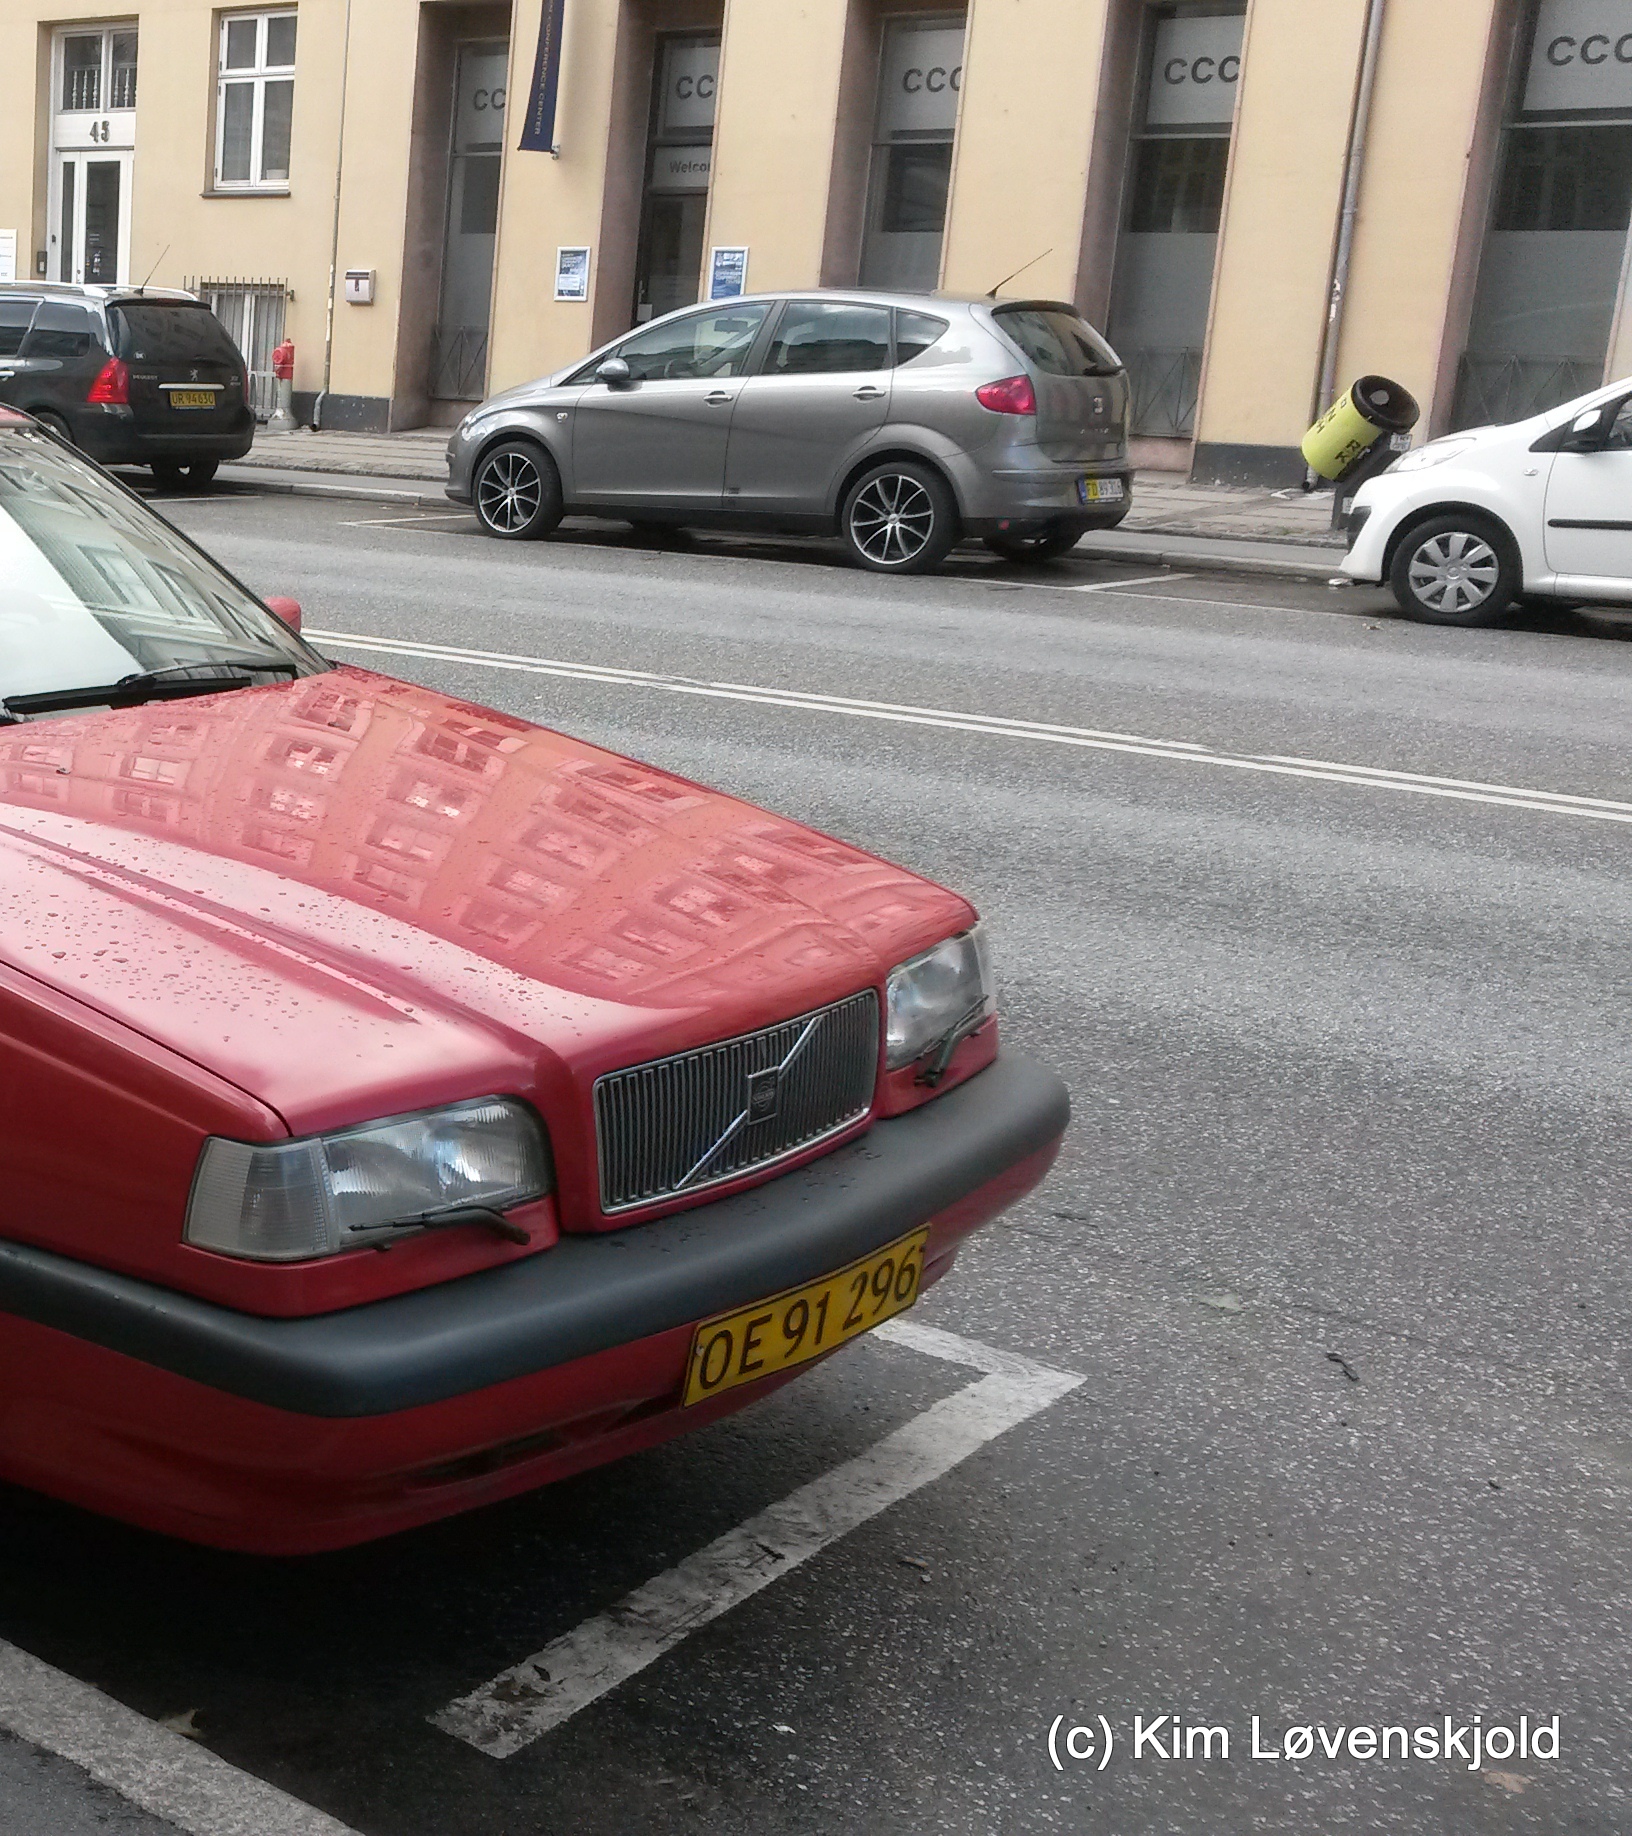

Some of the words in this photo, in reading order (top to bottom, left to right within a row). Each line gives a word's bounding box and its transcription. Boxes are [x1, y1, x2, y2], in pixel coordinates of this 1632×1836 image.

[1164, 55, 1241, 85] CCC
[534, 92, 545, 135] CENTER
[171, 393, 185, 404] UR
[699, 1313, 773, 1390] OE
[782, 1290, 831, 1359] 91
[842, 1245, 916, 1331] 296
